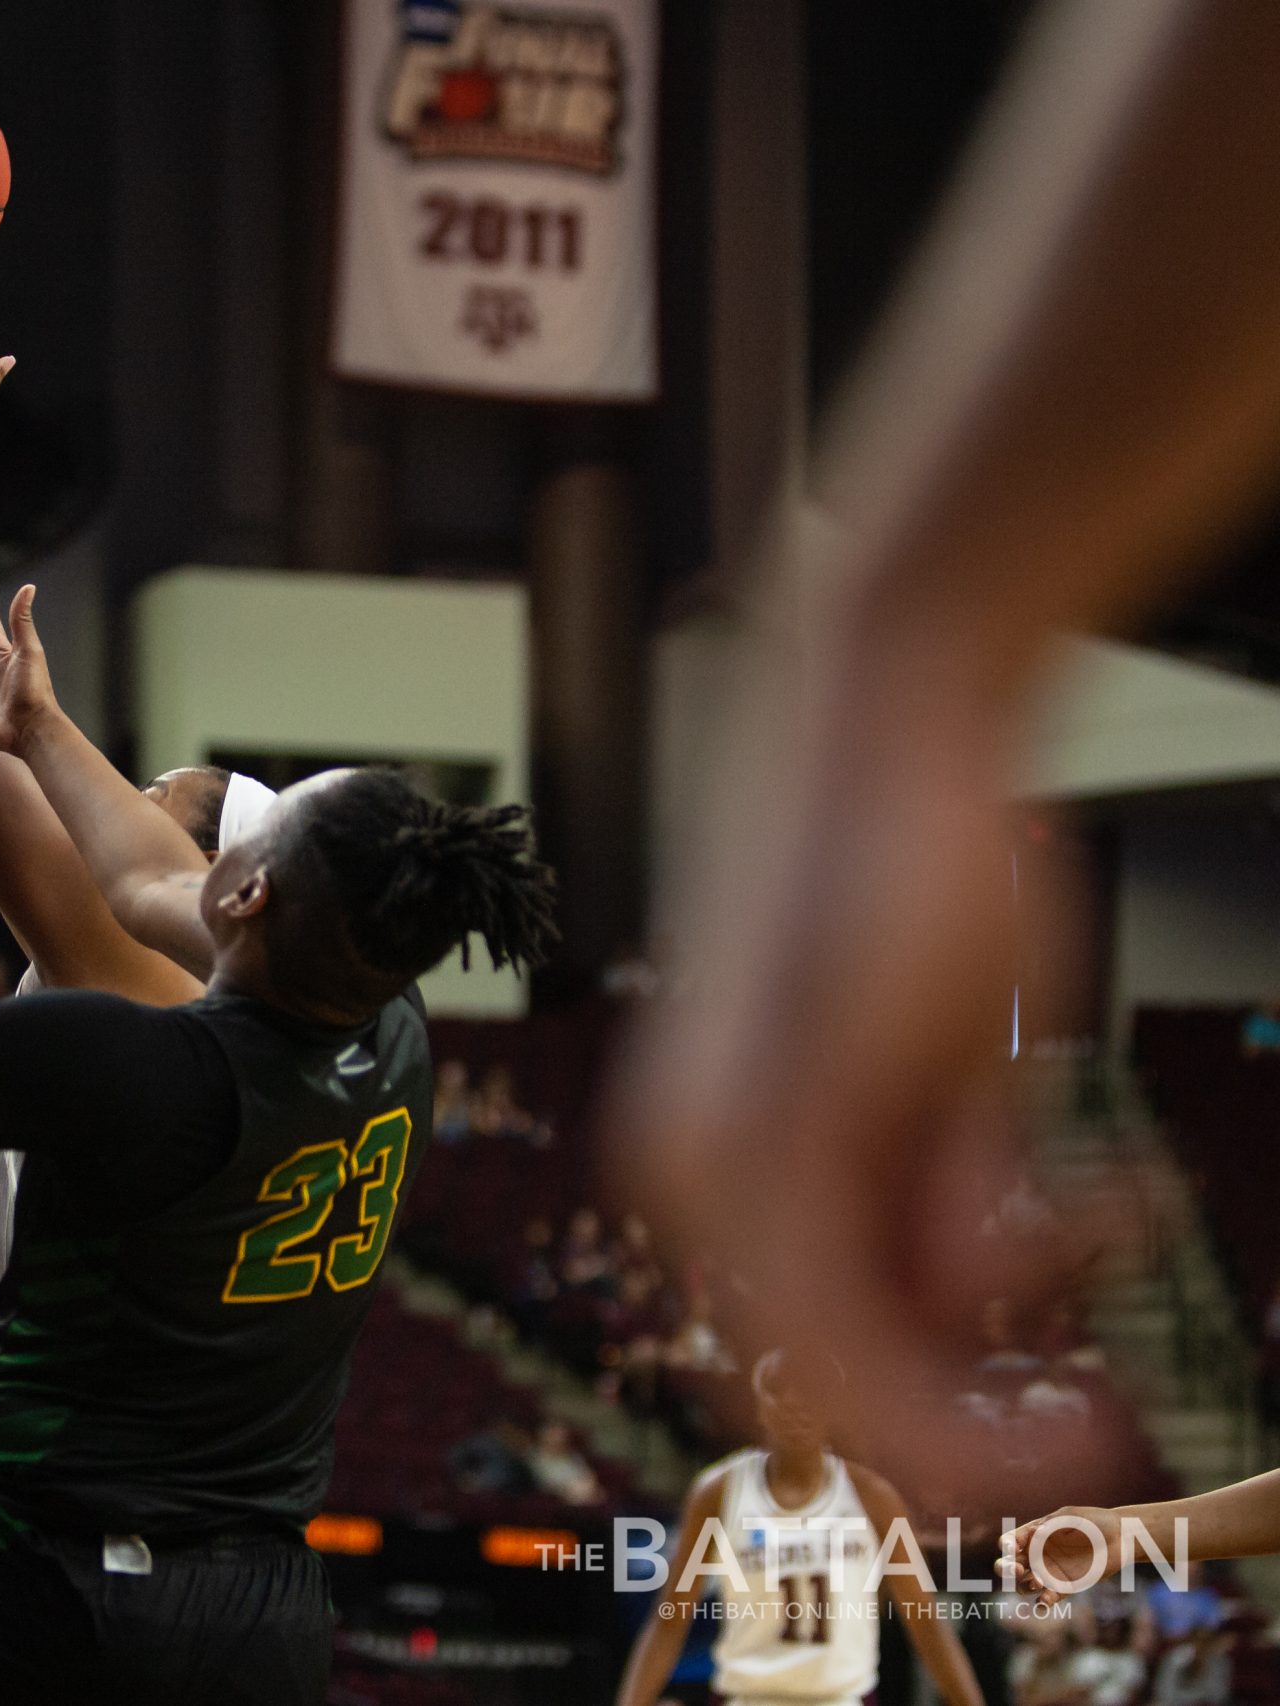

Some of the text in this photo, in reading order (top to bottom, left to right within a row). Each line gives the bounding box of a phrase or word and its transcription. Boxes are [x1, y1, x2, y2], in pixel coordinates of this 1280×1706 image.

[417, 187, 582, 276] 2011
[222, 1106, 412, 1304] 23
[778, 1574, 829, 1645] 11
